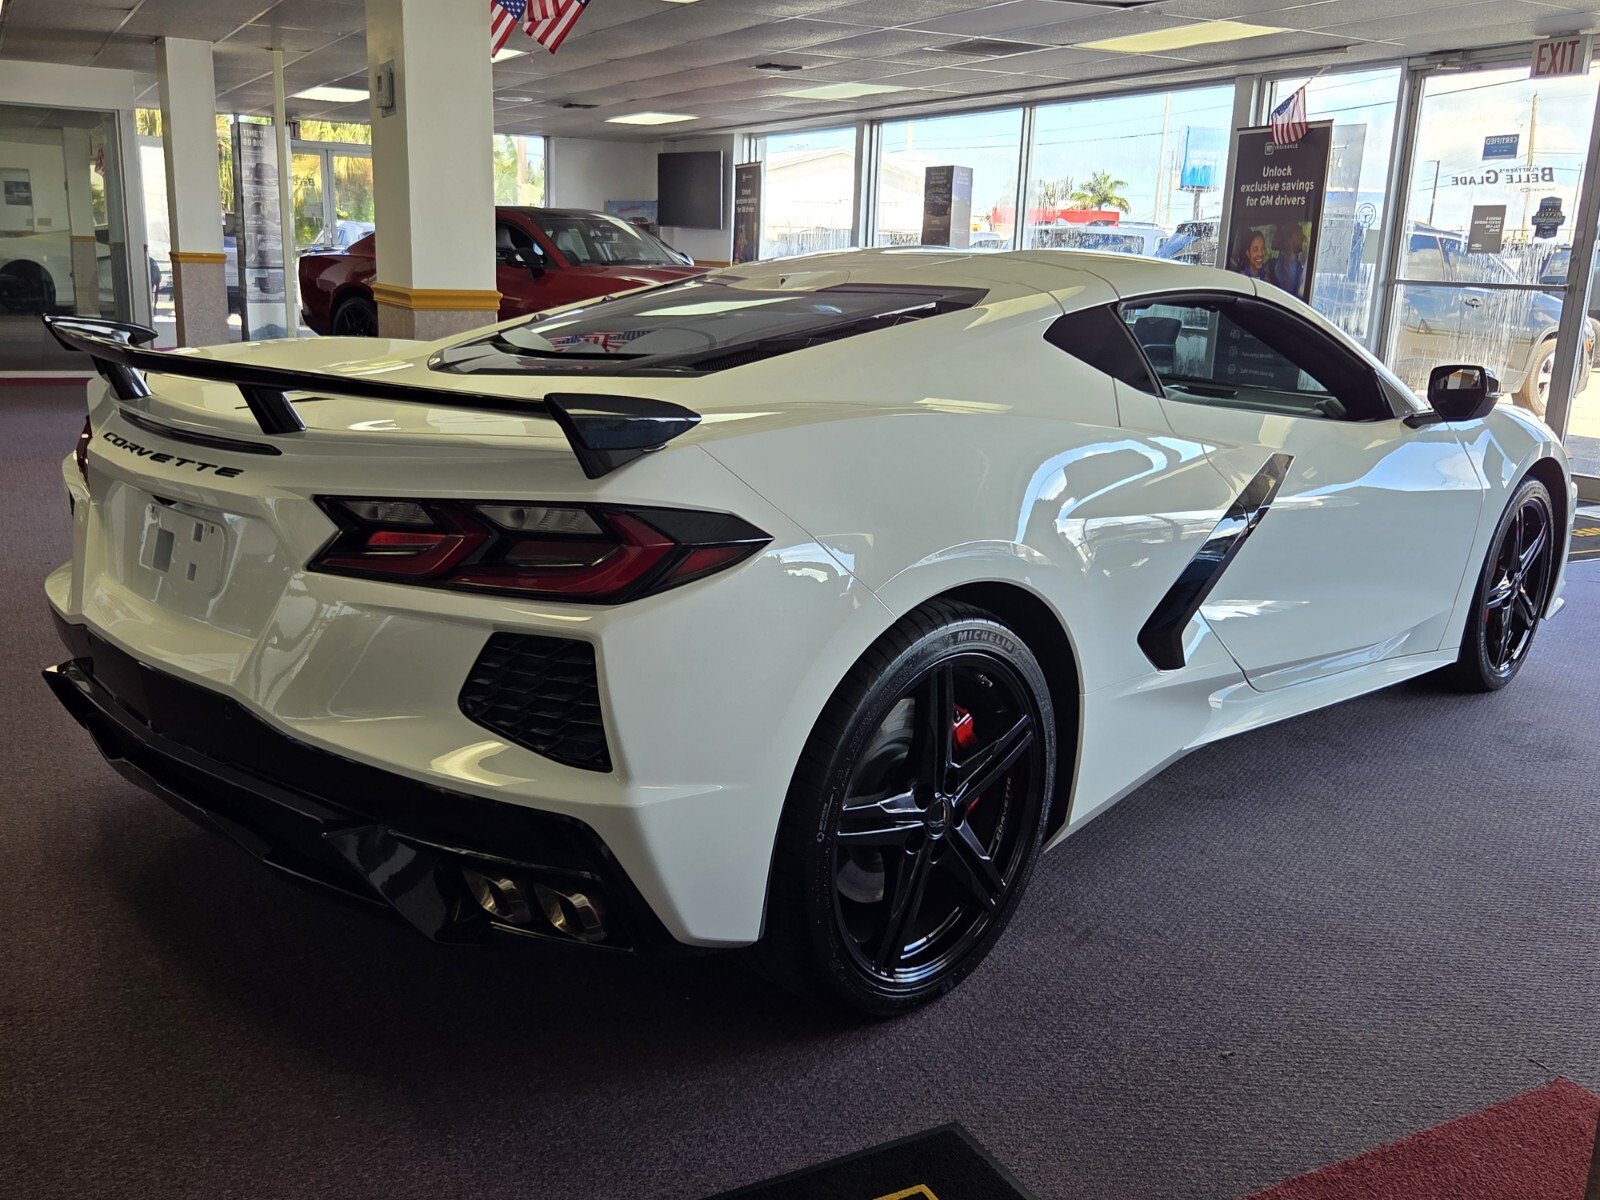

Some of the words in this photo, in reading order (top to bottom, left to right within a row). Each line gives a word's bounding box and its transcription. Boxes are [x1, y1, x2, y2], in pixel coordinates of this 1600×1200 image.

[1535, 40, 1580, 75] EXIT
[1262, 165, 1292, 178] Unlock
[1240, 181, 1280, 193] exclusive
[1281, 179, 1314, 193] savings
[1246, 195, 1259, 207] for
[1260, 195, 1273, 206] GM
[1274, 194, 1306, 206] drivers
[103, 431, 245, 478] CORVETTE
[957, 630, 1014, 651] MICHELIN
